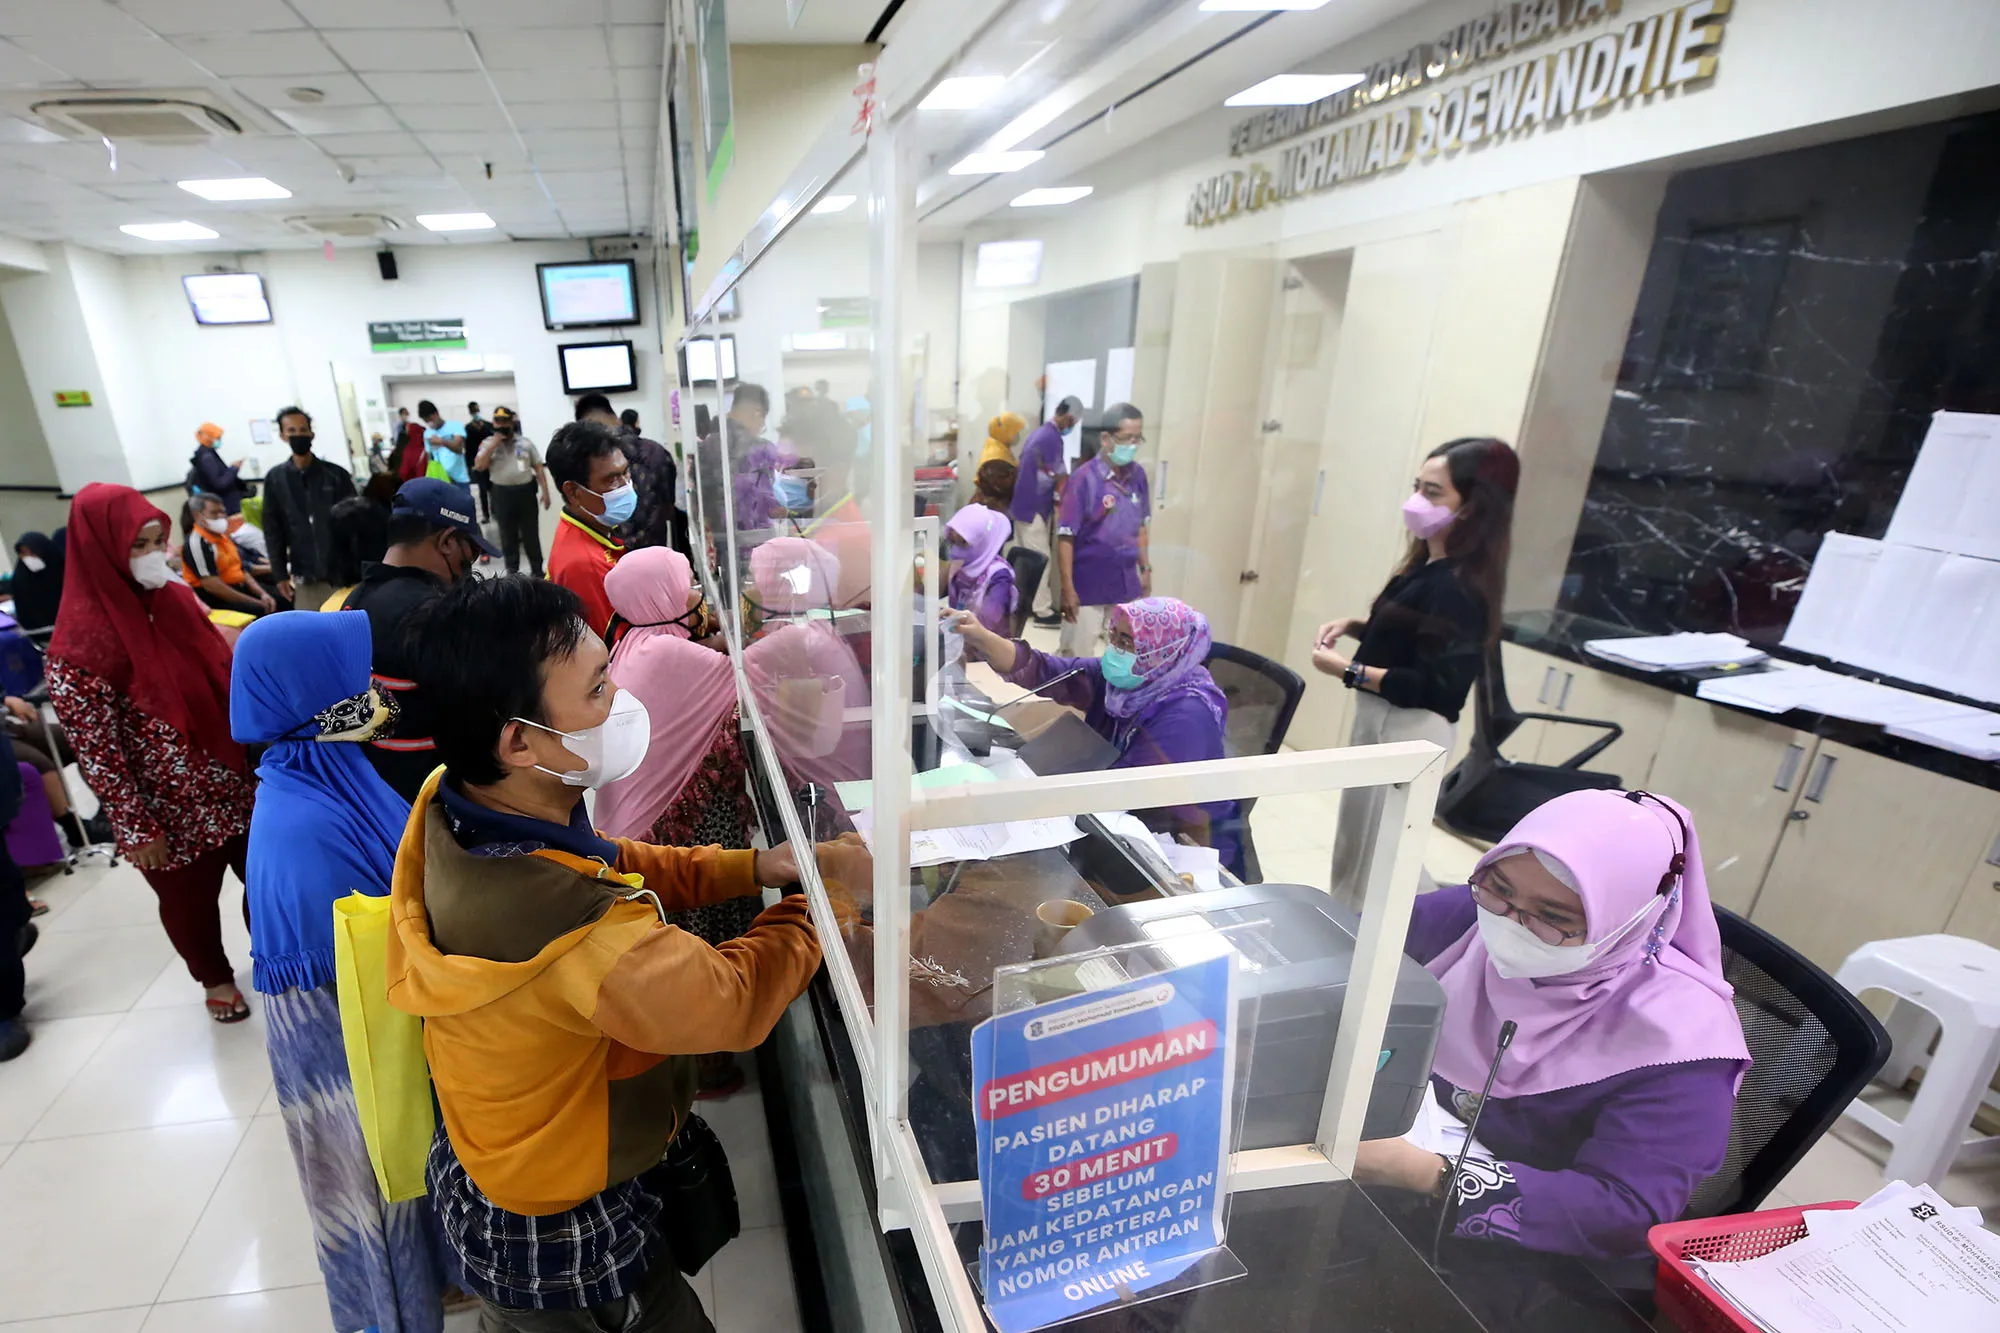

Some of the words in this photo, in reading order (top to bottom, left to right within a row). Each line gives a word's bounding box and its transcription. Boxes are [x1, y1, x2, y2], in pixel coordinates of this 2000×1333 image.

[1278, 106, 1411, 200] MOHAMAD
[1418, 0, 1716, 150] SOEWANDHIE
[989, 1030, 1206, 1110] PENGUMUMAN
[995, 1113, 1087, 1154] PASIEN
[1094, 1078, 1206, 1125] DIHARAP
[1048, 1118, 1155, 1163] DATANG
[1034, 1169, 1071, 1194] 30
[1079, 1138, 1168, 1181] MENIT
[1047, 1167, 1155, 1213] SEBELUM
[987, 1225, 1039, 1254] JAM
[1046, 1172, 1213, 1236] KEDATANGAN
[995, 1239, 1065, 1272] YANG
[1072, 1206, 1172, 1248] TERTERA
[1179, 1195, 1202, 1214] DI
[1935, 1220, 1954, 1236] RSUD
[1961, 1243, 1995, 1271] MOHAMAD
[998, 1251, 1090, 1297] NOMOR
[1096, 1216, 1199, 1263] ANTRIAN
[1063, 1260, 1151, 1301] ONLINE
